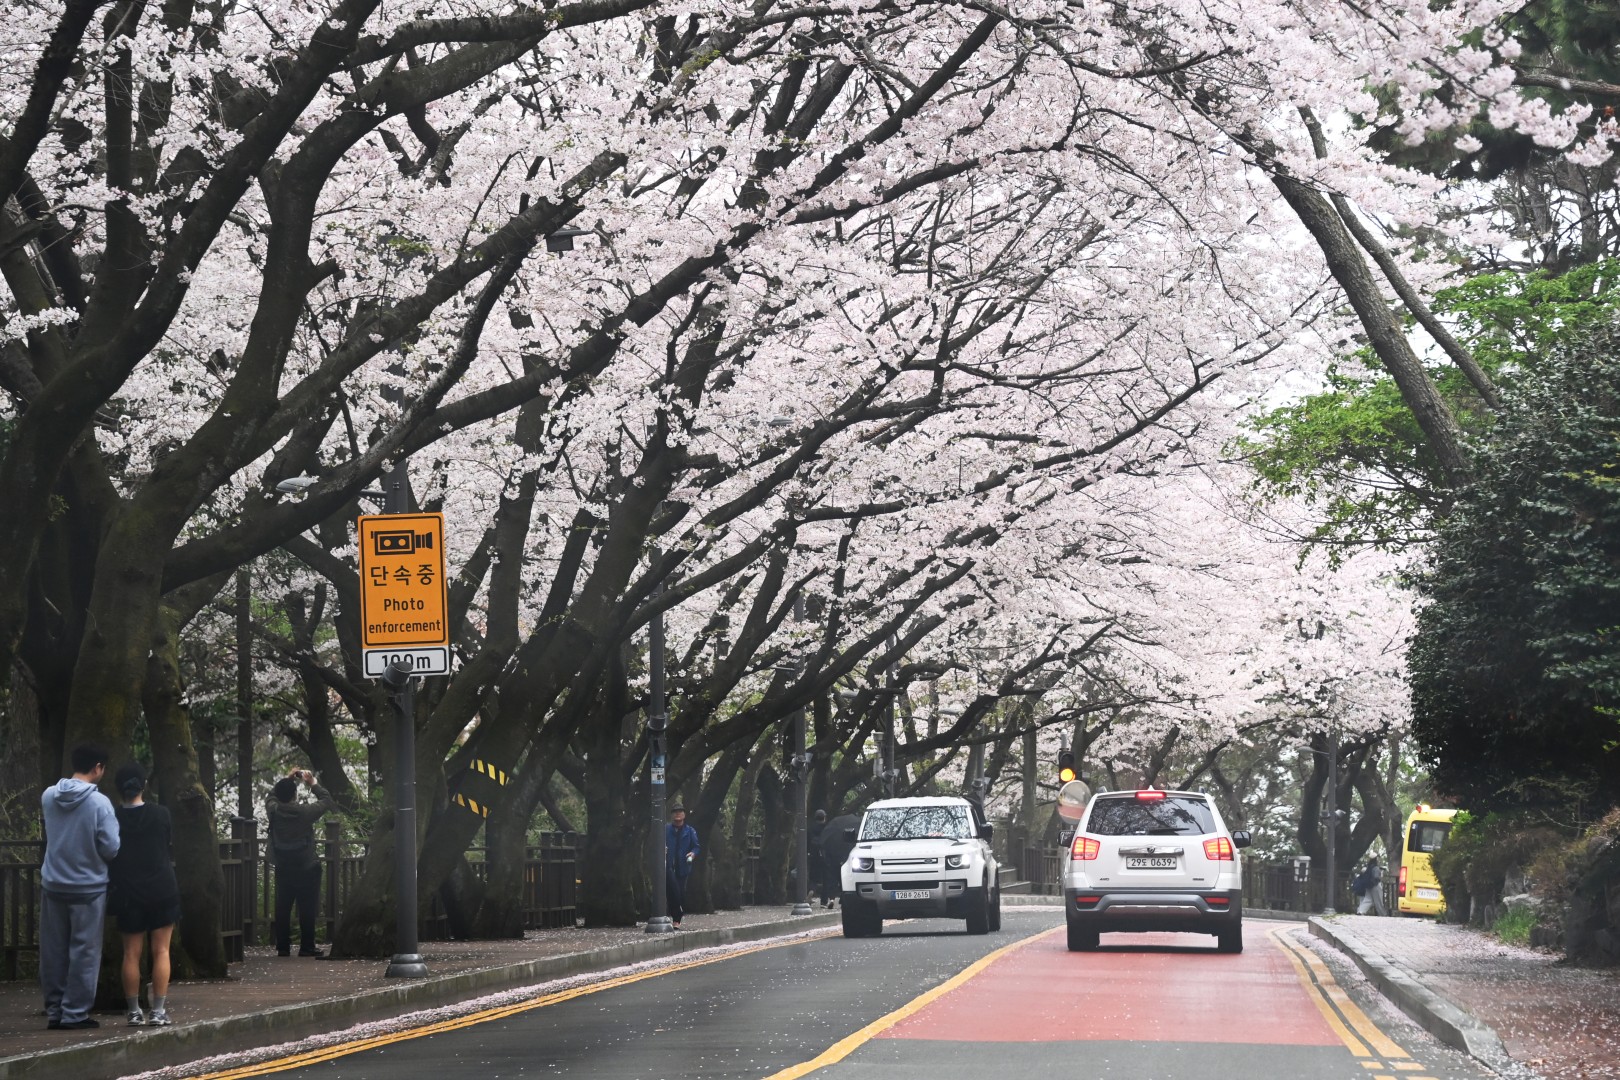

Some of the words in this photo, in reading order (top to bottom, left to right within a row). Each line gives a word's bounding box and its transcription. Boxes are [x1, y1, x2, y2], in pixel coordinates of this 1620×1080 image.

[383, 597, 425, 611] Photo
[369, 619, 441, 634] enforcement
[1150, 858, 1172, 866] 0639
